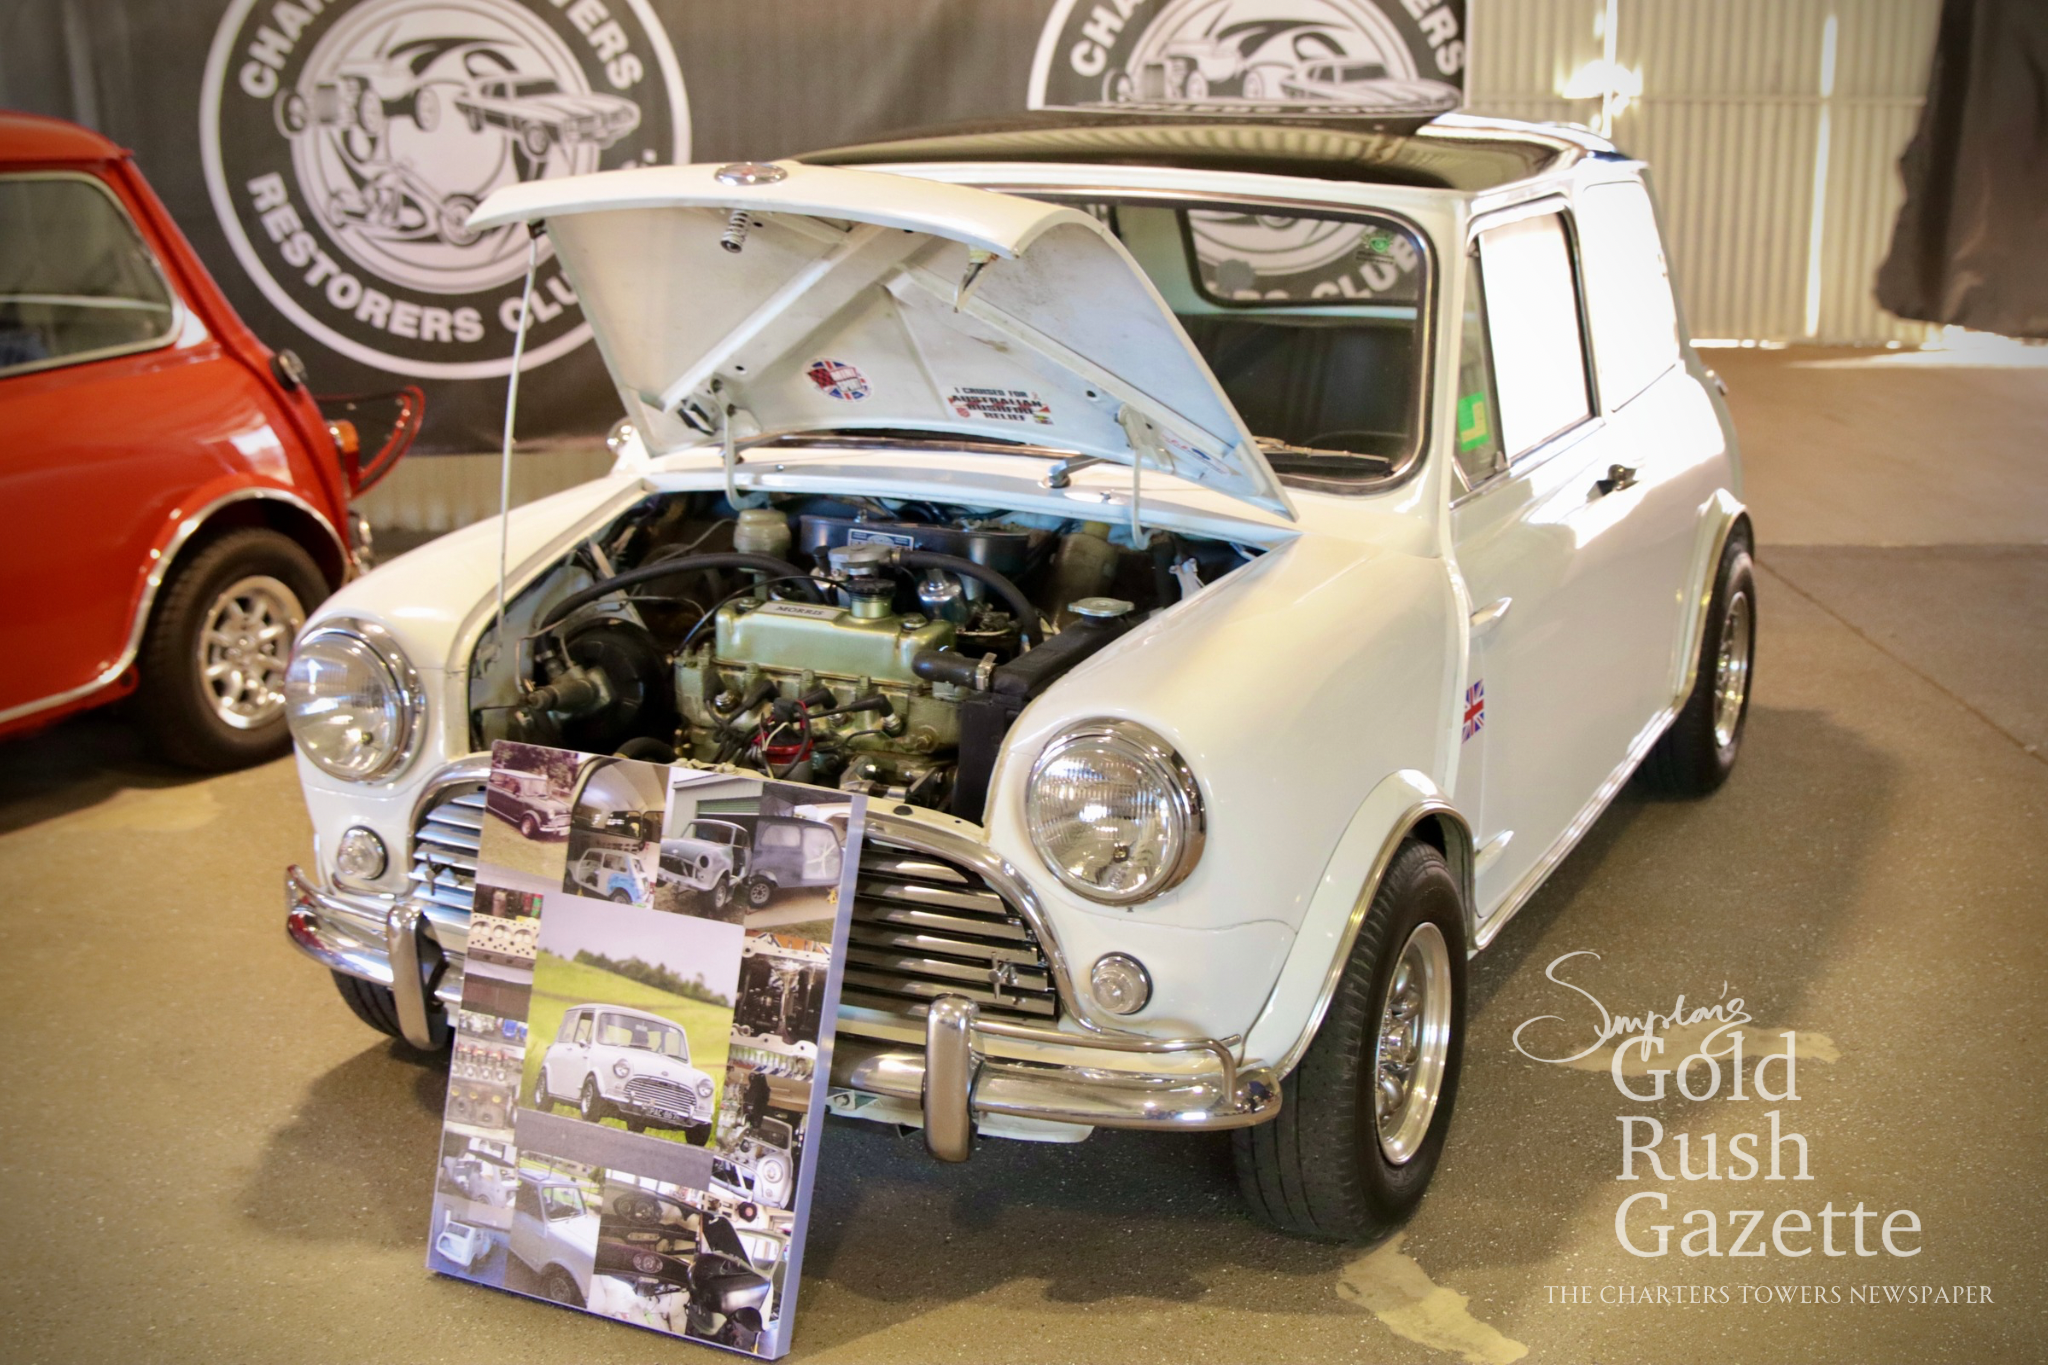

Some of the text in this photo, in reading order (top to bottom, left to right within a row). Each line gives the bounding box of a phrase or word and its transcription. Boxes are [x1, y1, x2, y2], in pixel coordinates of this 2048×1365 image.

[239, 0, 643, 99] CHA ERS
[247, 172, 579, 343] RESTORERS CLU
[1008, 390, 1028, 398] FOR
[952, 395, 1042, 407] AUSTRALIAN
[966, 404, 1034, 415] BUSHFIRE
[983, 412, 1026, 421] RELIEF
[775, 606, 825, 615] MORRIS
